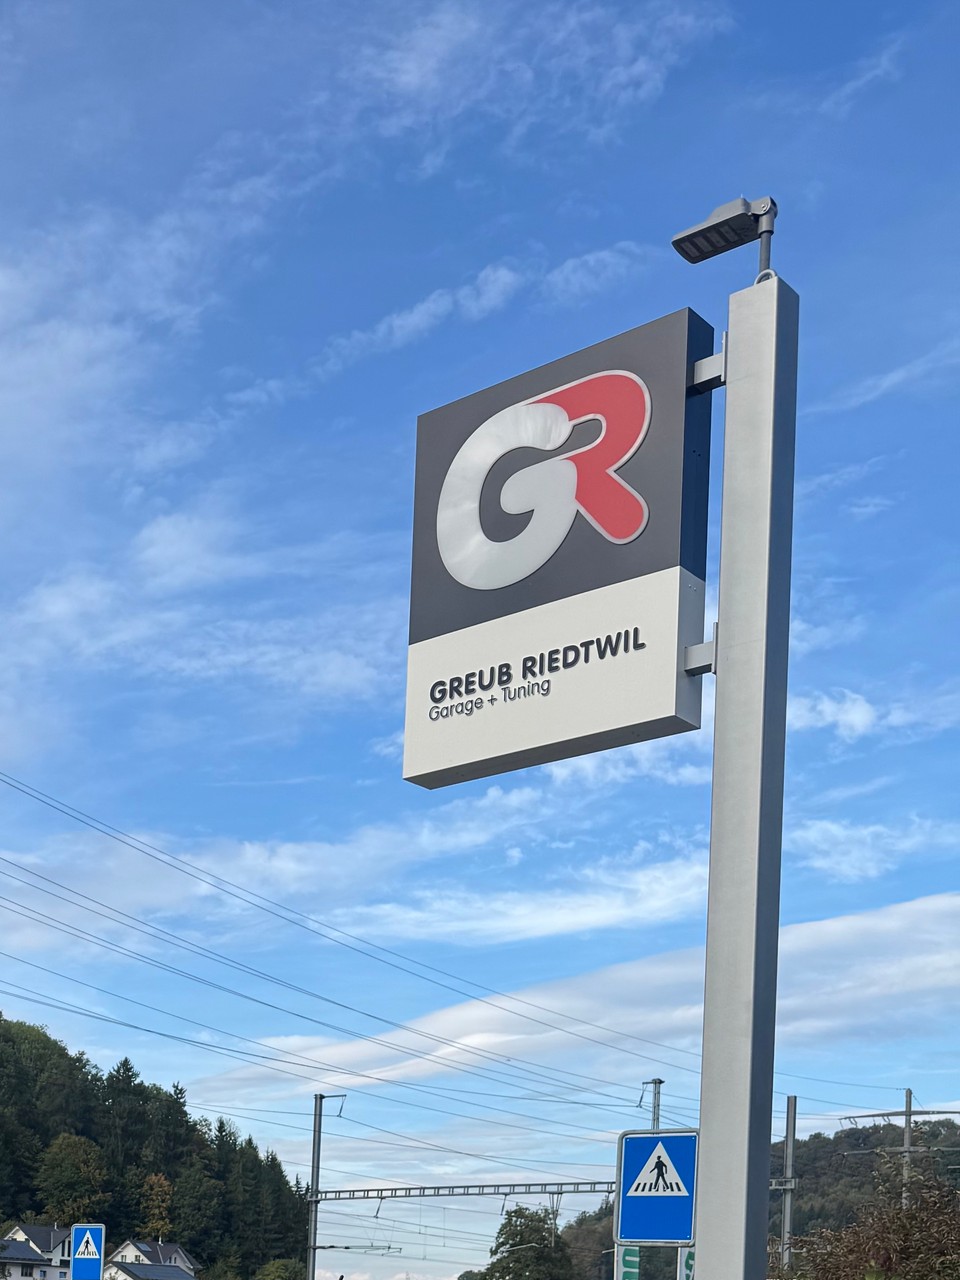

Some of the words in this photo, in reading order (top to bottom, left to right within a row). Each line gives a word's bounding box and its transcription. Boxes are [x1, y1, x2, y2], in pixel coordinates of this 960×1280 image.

[436, 369, 652, 591] GR
[428, 695, 484, 721] Garage
[487, 694, 497, 706] +
[500, 678, 551, 703] Tuning
[429, 662, 513, 704] GREUB
[521, 626, 646, 680] RIEDTWIL
